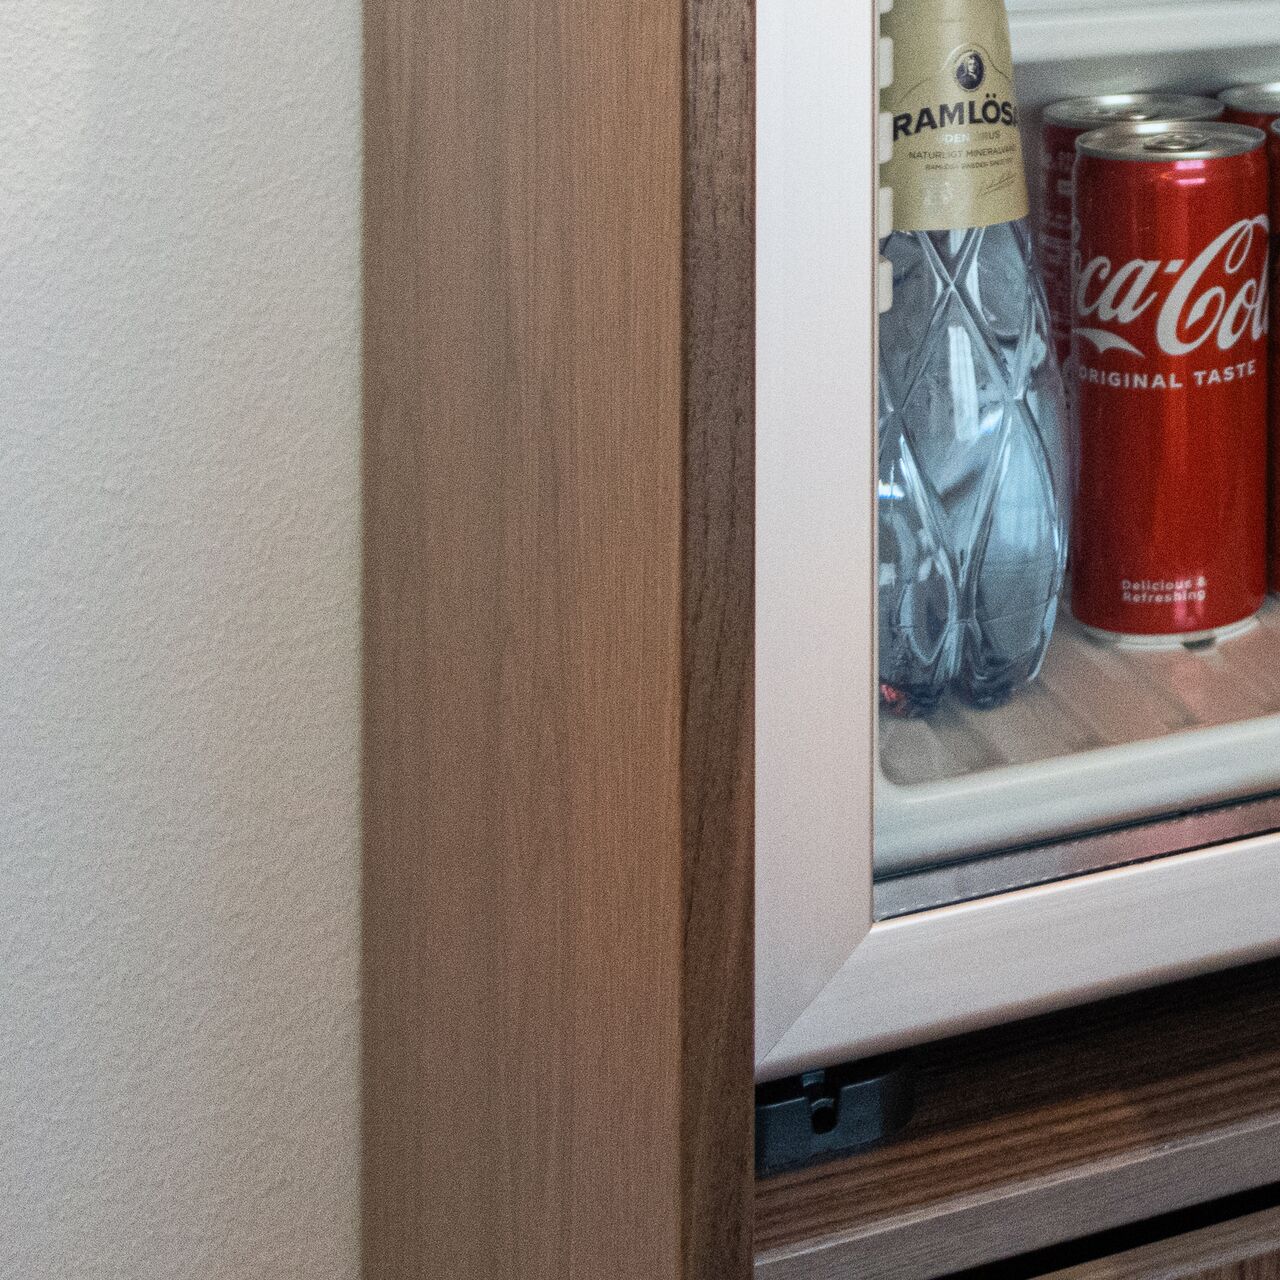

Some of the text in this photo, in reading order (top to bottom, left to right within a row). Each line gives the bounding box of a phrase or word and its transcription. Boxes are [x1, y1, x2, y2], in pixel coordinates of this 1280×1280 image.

[1079, 359, 1257, 390] ORIGINAL TASTE
[1121, 578, 1193, 592] Delicious
[1122, 589, 1207, 604] Refreshing
